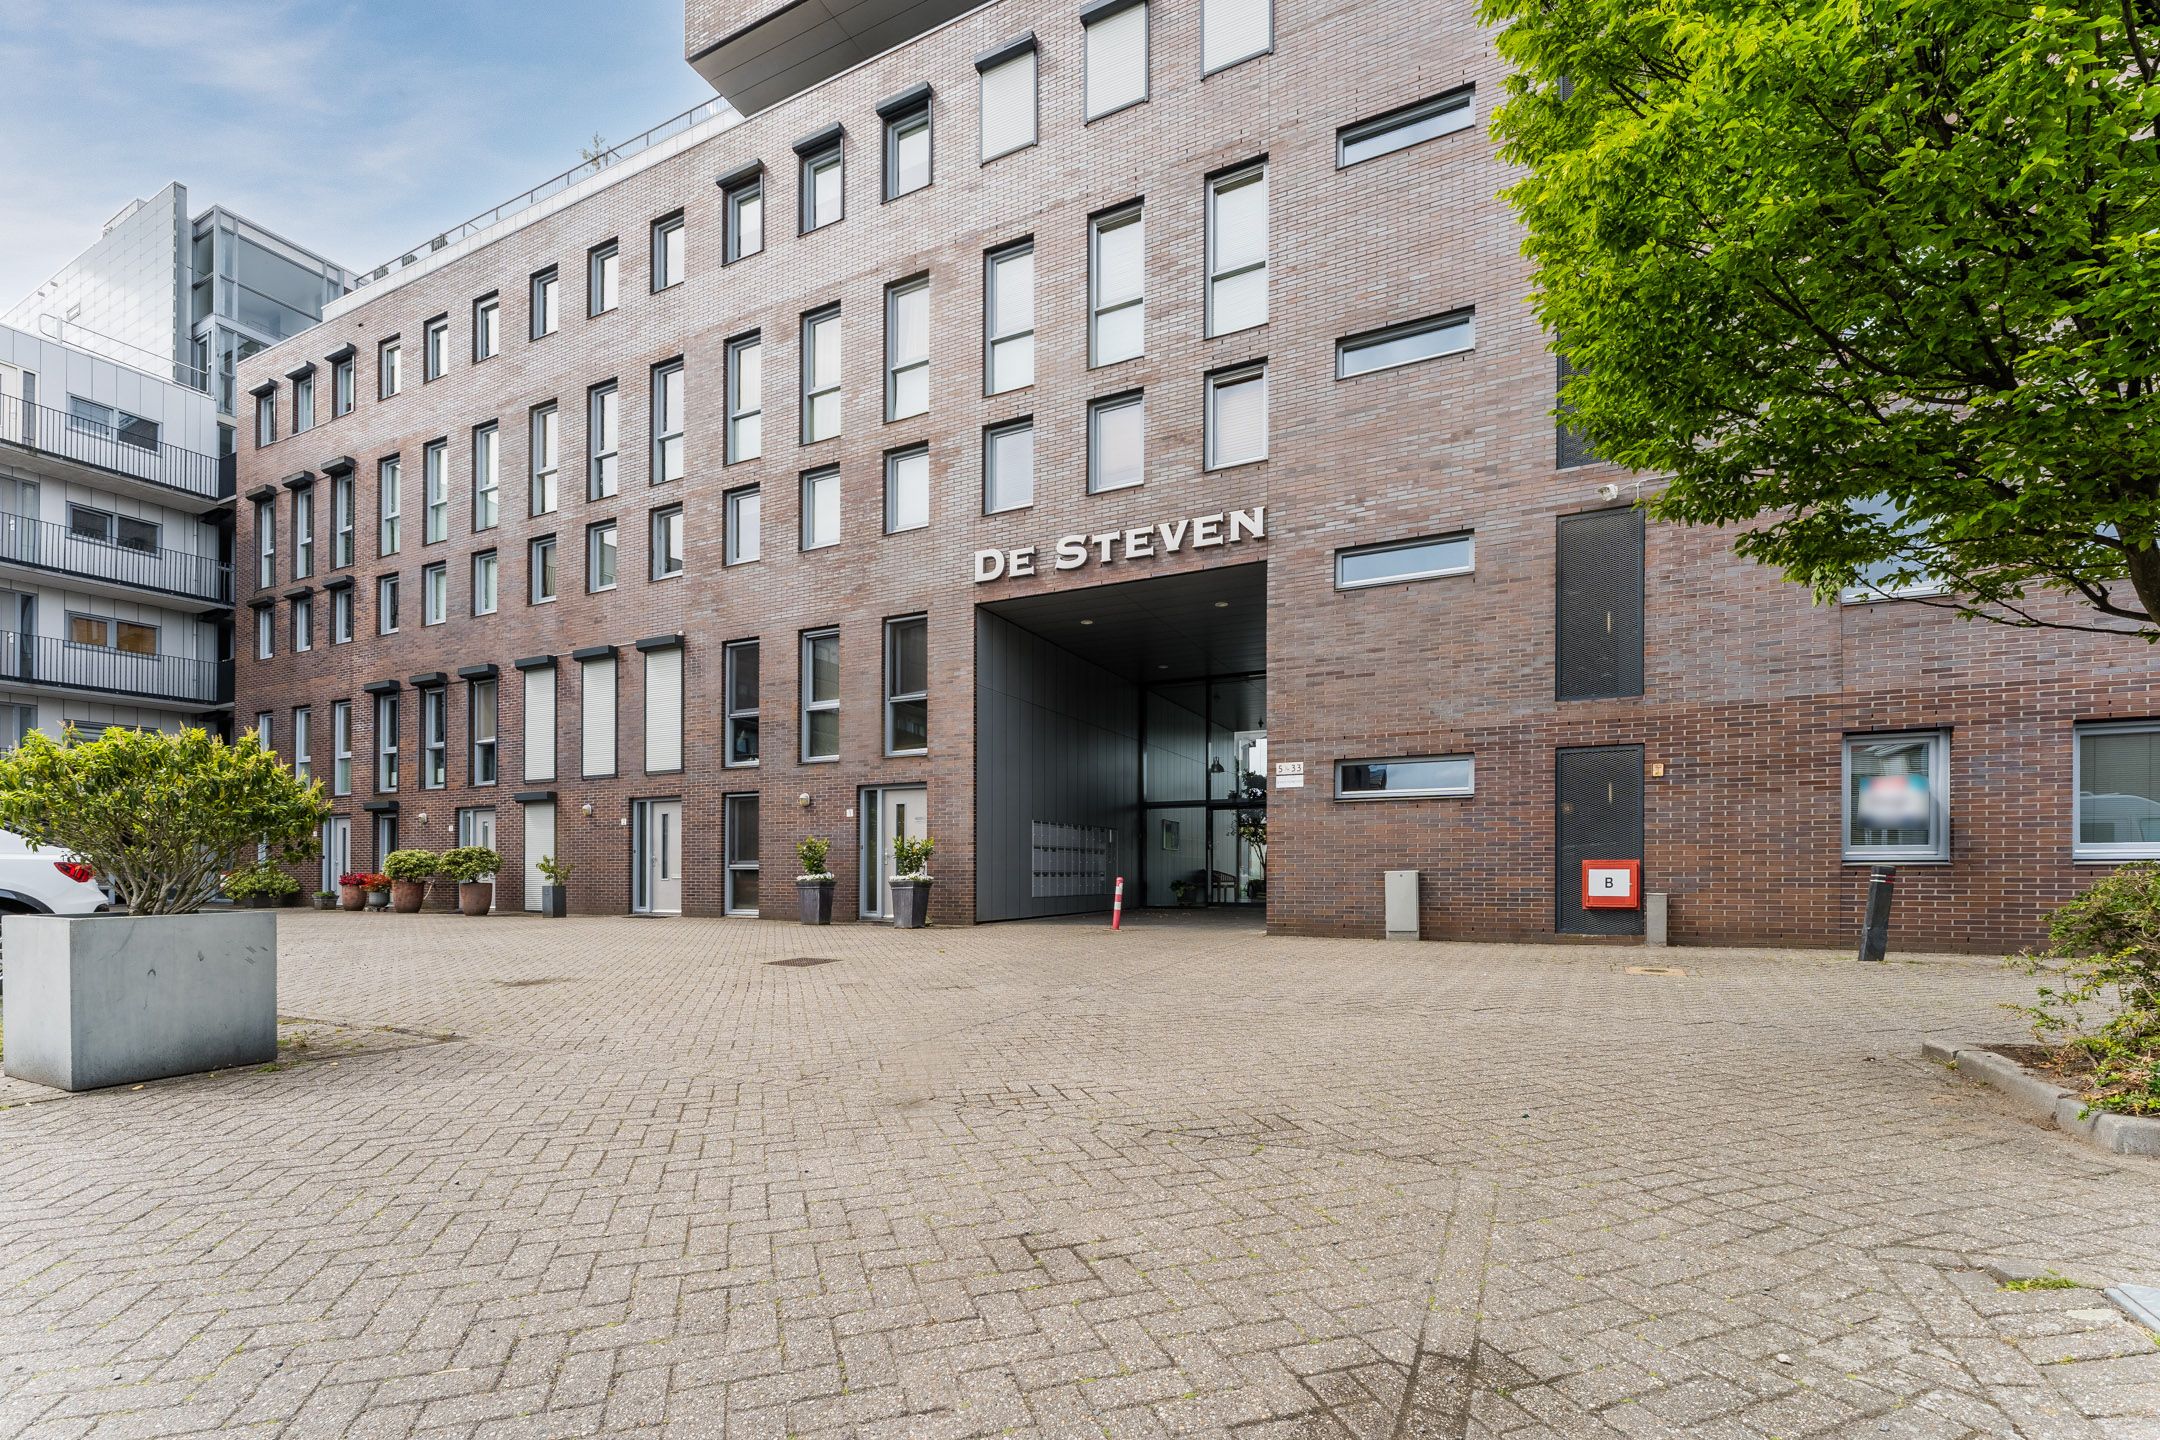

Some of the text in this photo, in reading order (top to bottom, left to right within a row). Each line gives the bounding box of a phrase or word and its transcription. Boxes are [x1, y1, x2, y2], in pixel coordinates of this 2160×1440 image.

[974, 506, 1266, 583] DE STEVEN
[1291, 763, 1302, 773] 33
[1605, 877, 1614, 889] B
